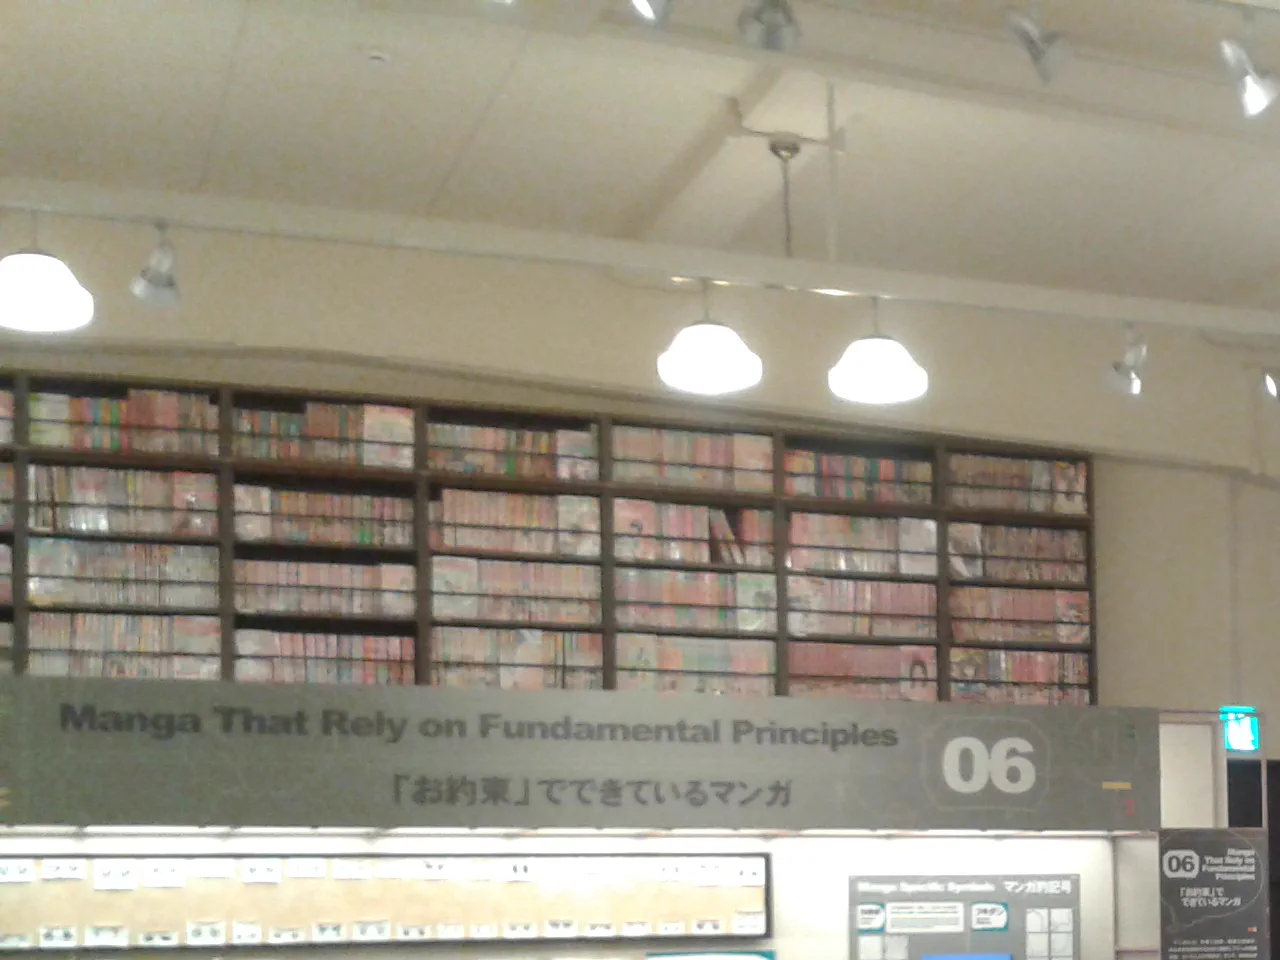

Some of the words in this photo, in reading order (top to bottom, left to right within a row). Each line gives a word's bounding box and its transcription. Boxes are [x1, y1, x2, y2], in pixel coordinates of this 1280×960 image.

[60, 703, 201, 740] Manga
[212, 706, 310, 737] That
[322, 709, 407, 744] Rely
[418, 718, 467, 738] on
[479, 712, 721, 744] Fundamental
[732, 719, 898, 752] Principles
[941, 736, 1037, 794] 06
[392, 773, 793, 808] 「お約束」でできているマンガ
[1167, 855, 1196, 873] 06
